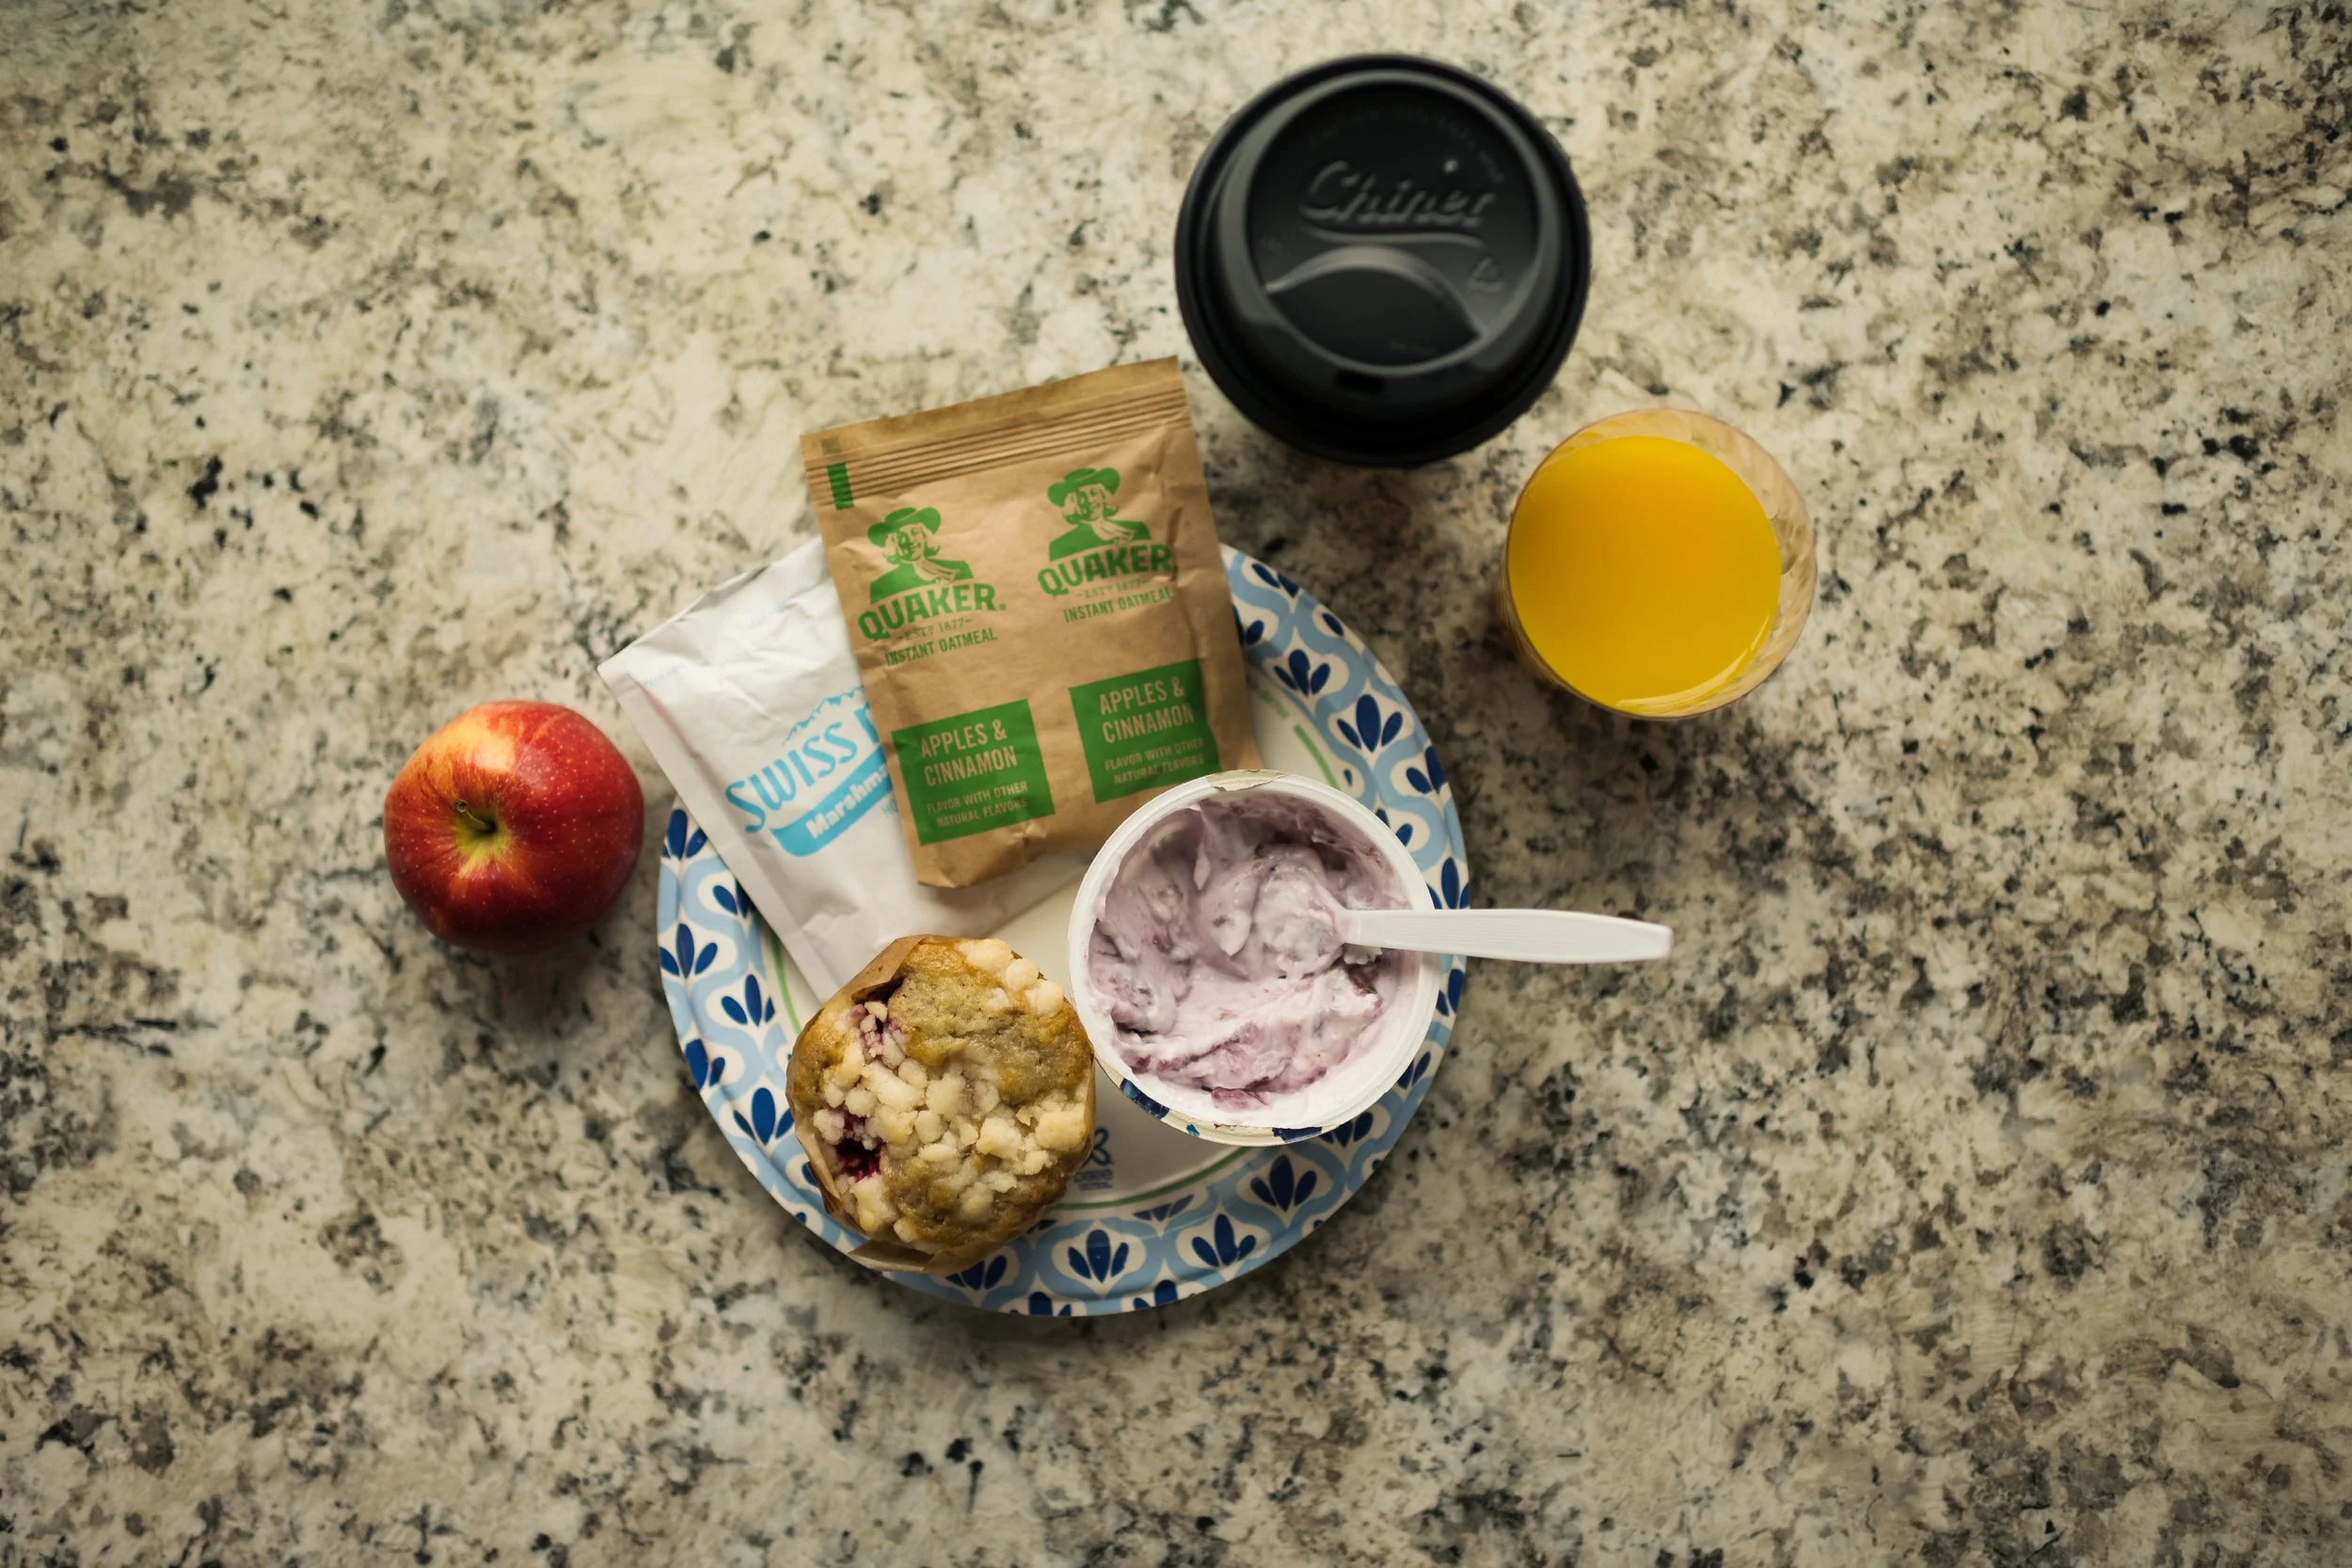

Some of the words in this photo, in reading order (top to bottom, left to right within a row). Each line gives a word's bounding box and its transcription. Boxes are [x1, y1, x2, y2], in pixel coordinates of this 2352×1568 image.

[1063, 600, 1115, 624] INSTANT
[1118, 587, 1174, 611] OATMEAL
[883, 640, 935, 666] INSTANT
[939, 626, 998, 652] OATMEAL
[1099, 679, 1168, 715] APPLES
[1171, 676, 1186, 698] &
[920, 722, 988, 759] APPLES
[992, 718, 1009, 741] &
[1102, 703, 1195, 744] CINNAMON
[923, 744, 1019, 787] CINNAMON
[1104, 752, 1143, 771] FLAVOR
[1145, 744, 1173, 761] WITH
[1174, 736, 1205, 752] OTHER
[724, 721, 858, 834] SWISS
[1113, 766, 1161, 786] NATURAL
[926, 797, 961, 815] FLAVOR
[962, 790, 992, 807] WITH
[993, 780, 1028, 800] OTHER
[936, 809, 980, 829] NATURAL
[983, 798, 1028, 818] FLAVORS
